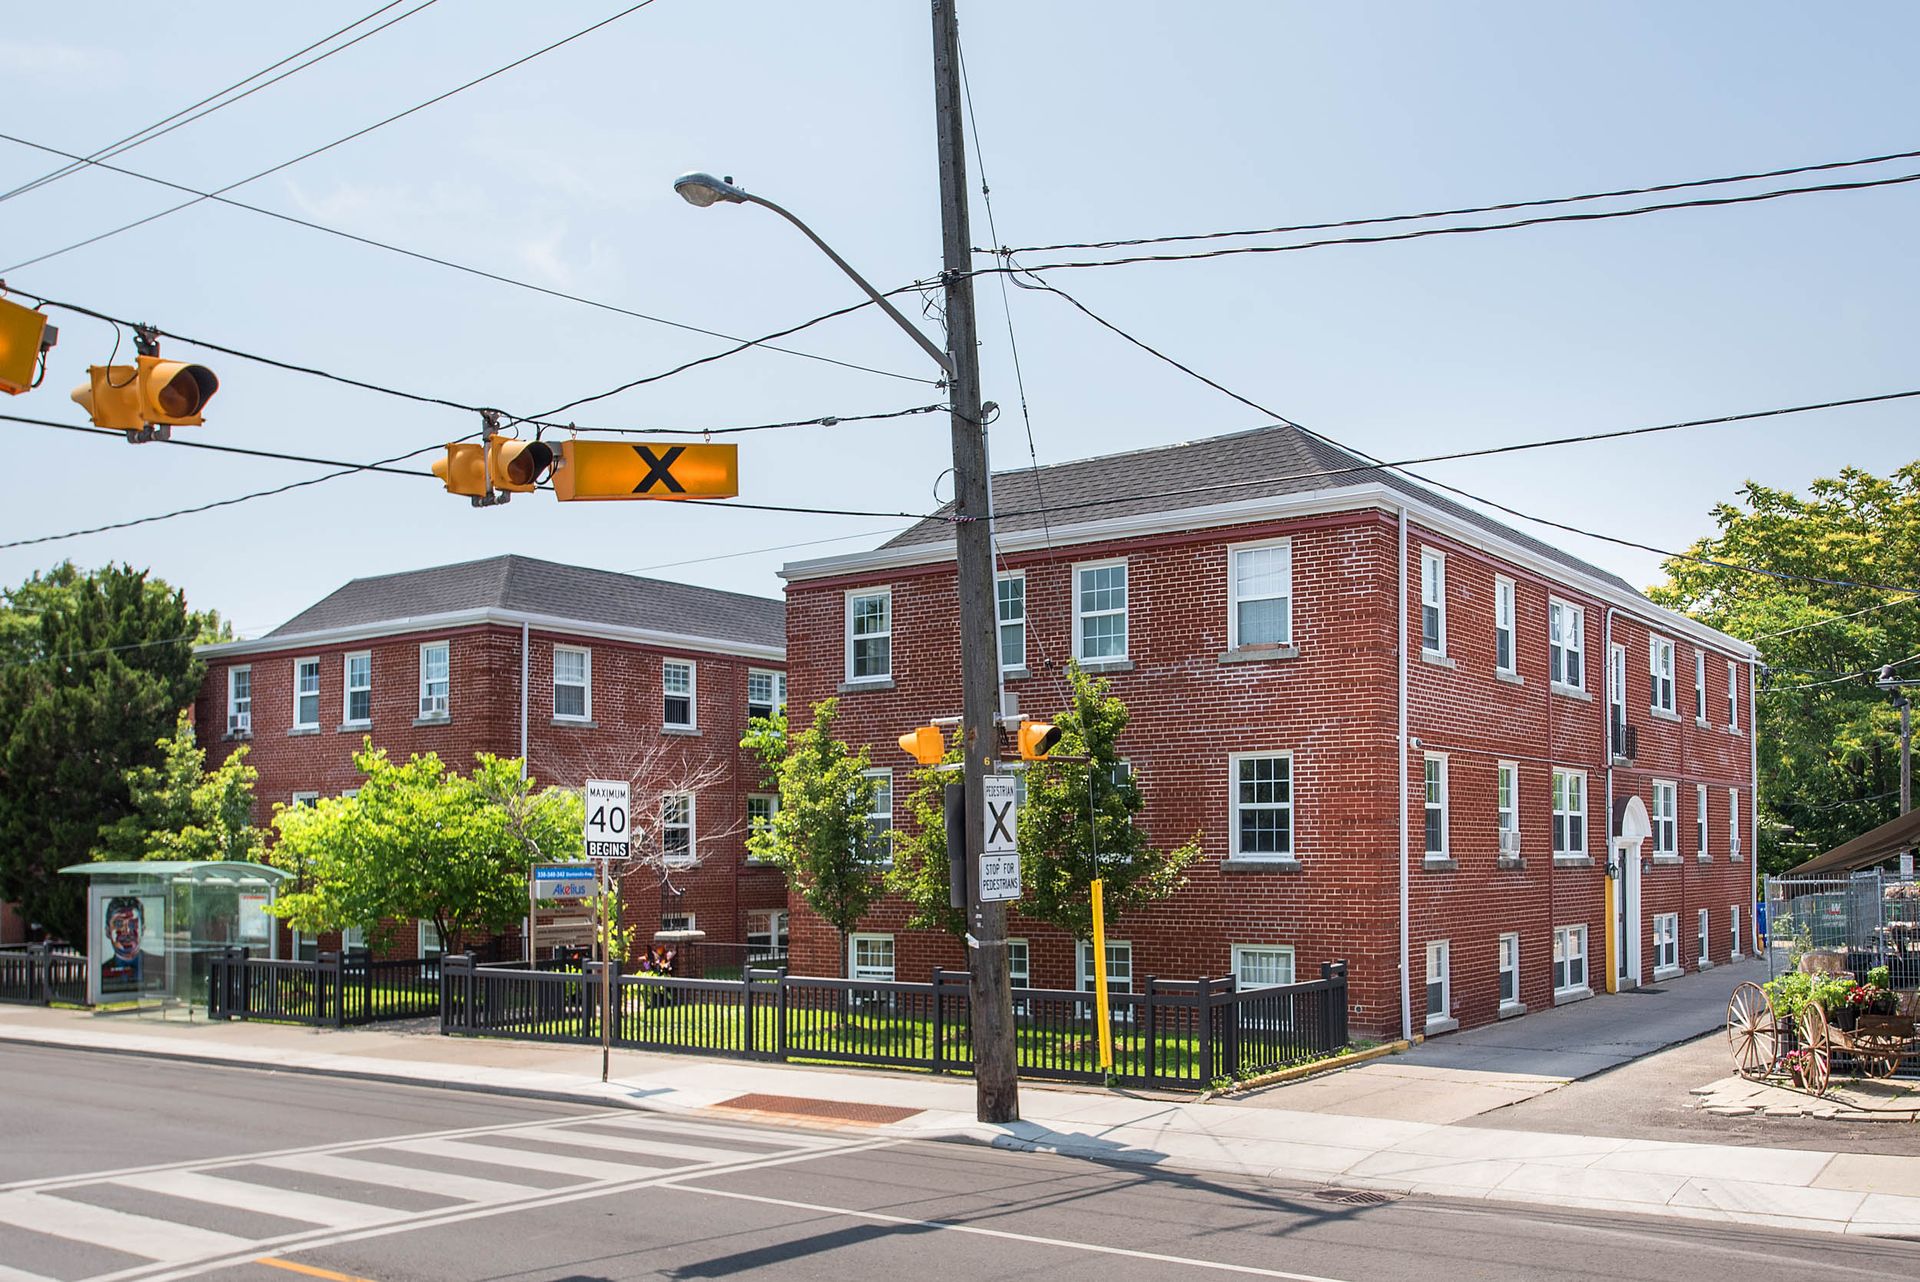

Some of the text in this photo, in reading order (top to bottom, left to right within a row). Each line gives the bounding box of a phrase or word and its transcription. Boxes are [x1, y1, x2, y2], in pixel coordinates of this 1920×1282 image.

[632, 445, 687, 494] X
[589, 788, 626, 799] MAXIMUM
[985, 785, 1014, 798] PEDESTRIAN
[589, 805, 626, 833] 40
[987, 801, 1014, 844] X
[589, 842, 627, 857] BEGINS
[985, 862, 1015, 876] STOP FOR
[552, 883, 586, 896] Akelius
[983, 877, 1019, 891] PEDESTRIANS
